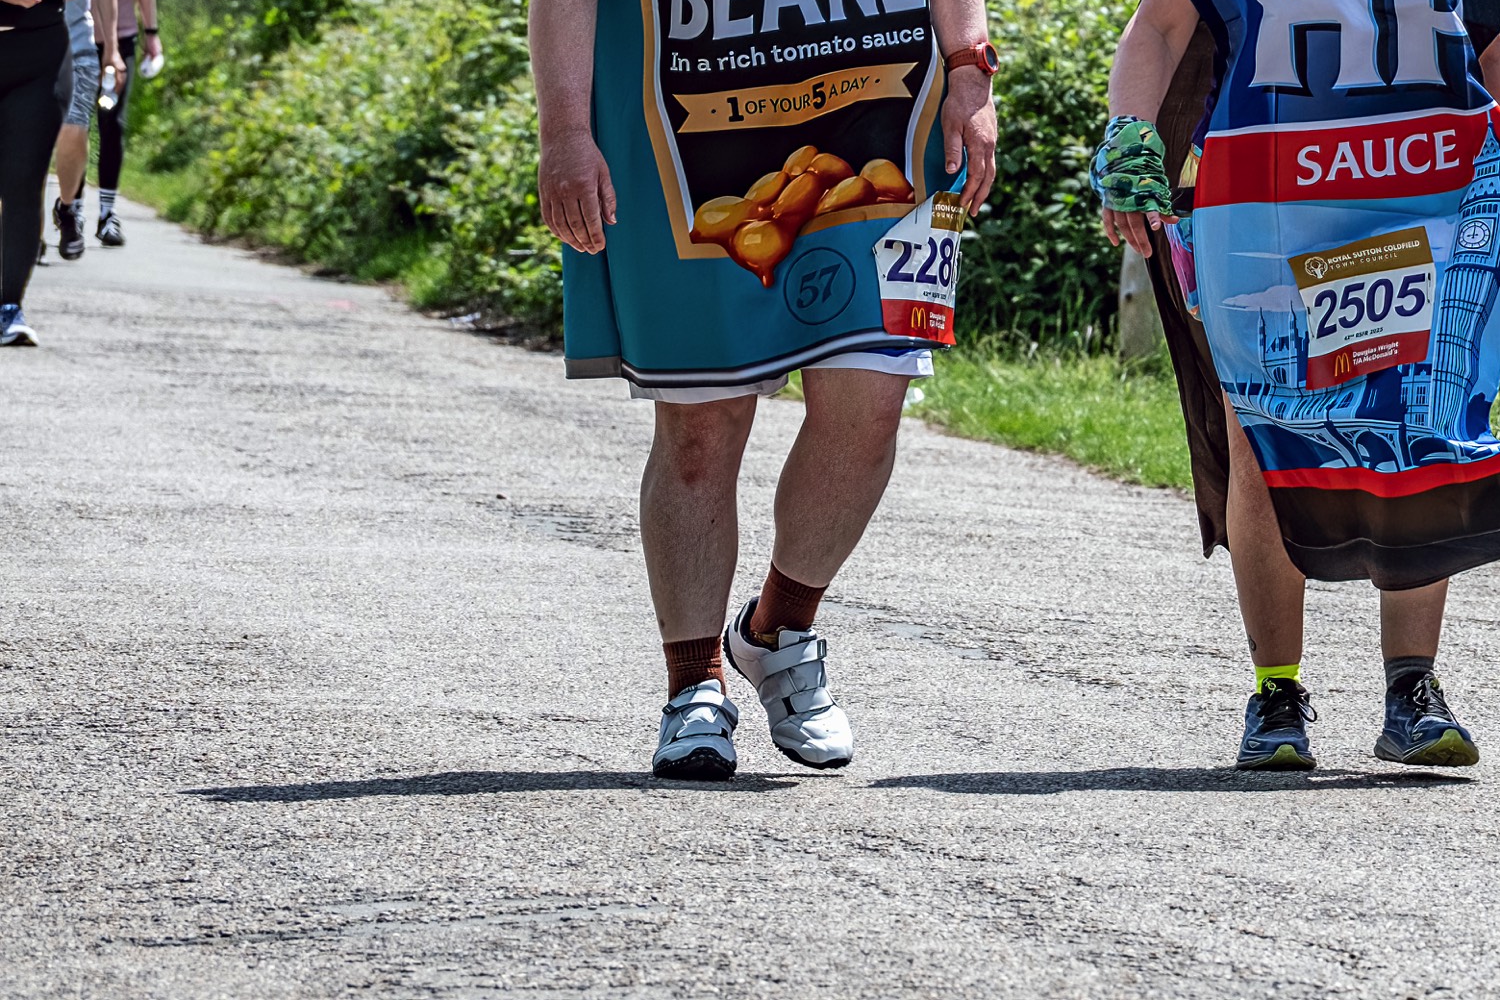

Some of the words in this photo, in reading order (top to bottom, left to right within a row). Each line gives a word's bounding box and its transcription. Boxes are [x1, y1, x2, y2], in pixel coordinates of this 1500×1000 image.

[670, 51, 691, 72] In
[697, 58, 711, 72] a
[717, 46, 766, 71] rich
[771, 34, 857, 63] tomato
[862, 26, 926, 50] sauce
[726, 96, 745, 122] 1
[745, 98, 767, 114] OF
[771, 94, 811, 114] YOUR
[811, 82, 828, 110] 5
[828, 88, 839, 100] A
[839, 75, 870, 95] DAY
[1296, 128, 1461, 187] SAUCE
[1327, 254, 1352, 265] ROYAL
[1353, 246, 1382, 260] SUTTON
[1383, 239, 1420, 253] COLDFIELD
[1329, 260, 1355, 271] TOWN
[1360, 252, 1398, 264] COUNCIL
[796, 262, 842, 309] 57
[1314, 273, 1426, 339] 2505
